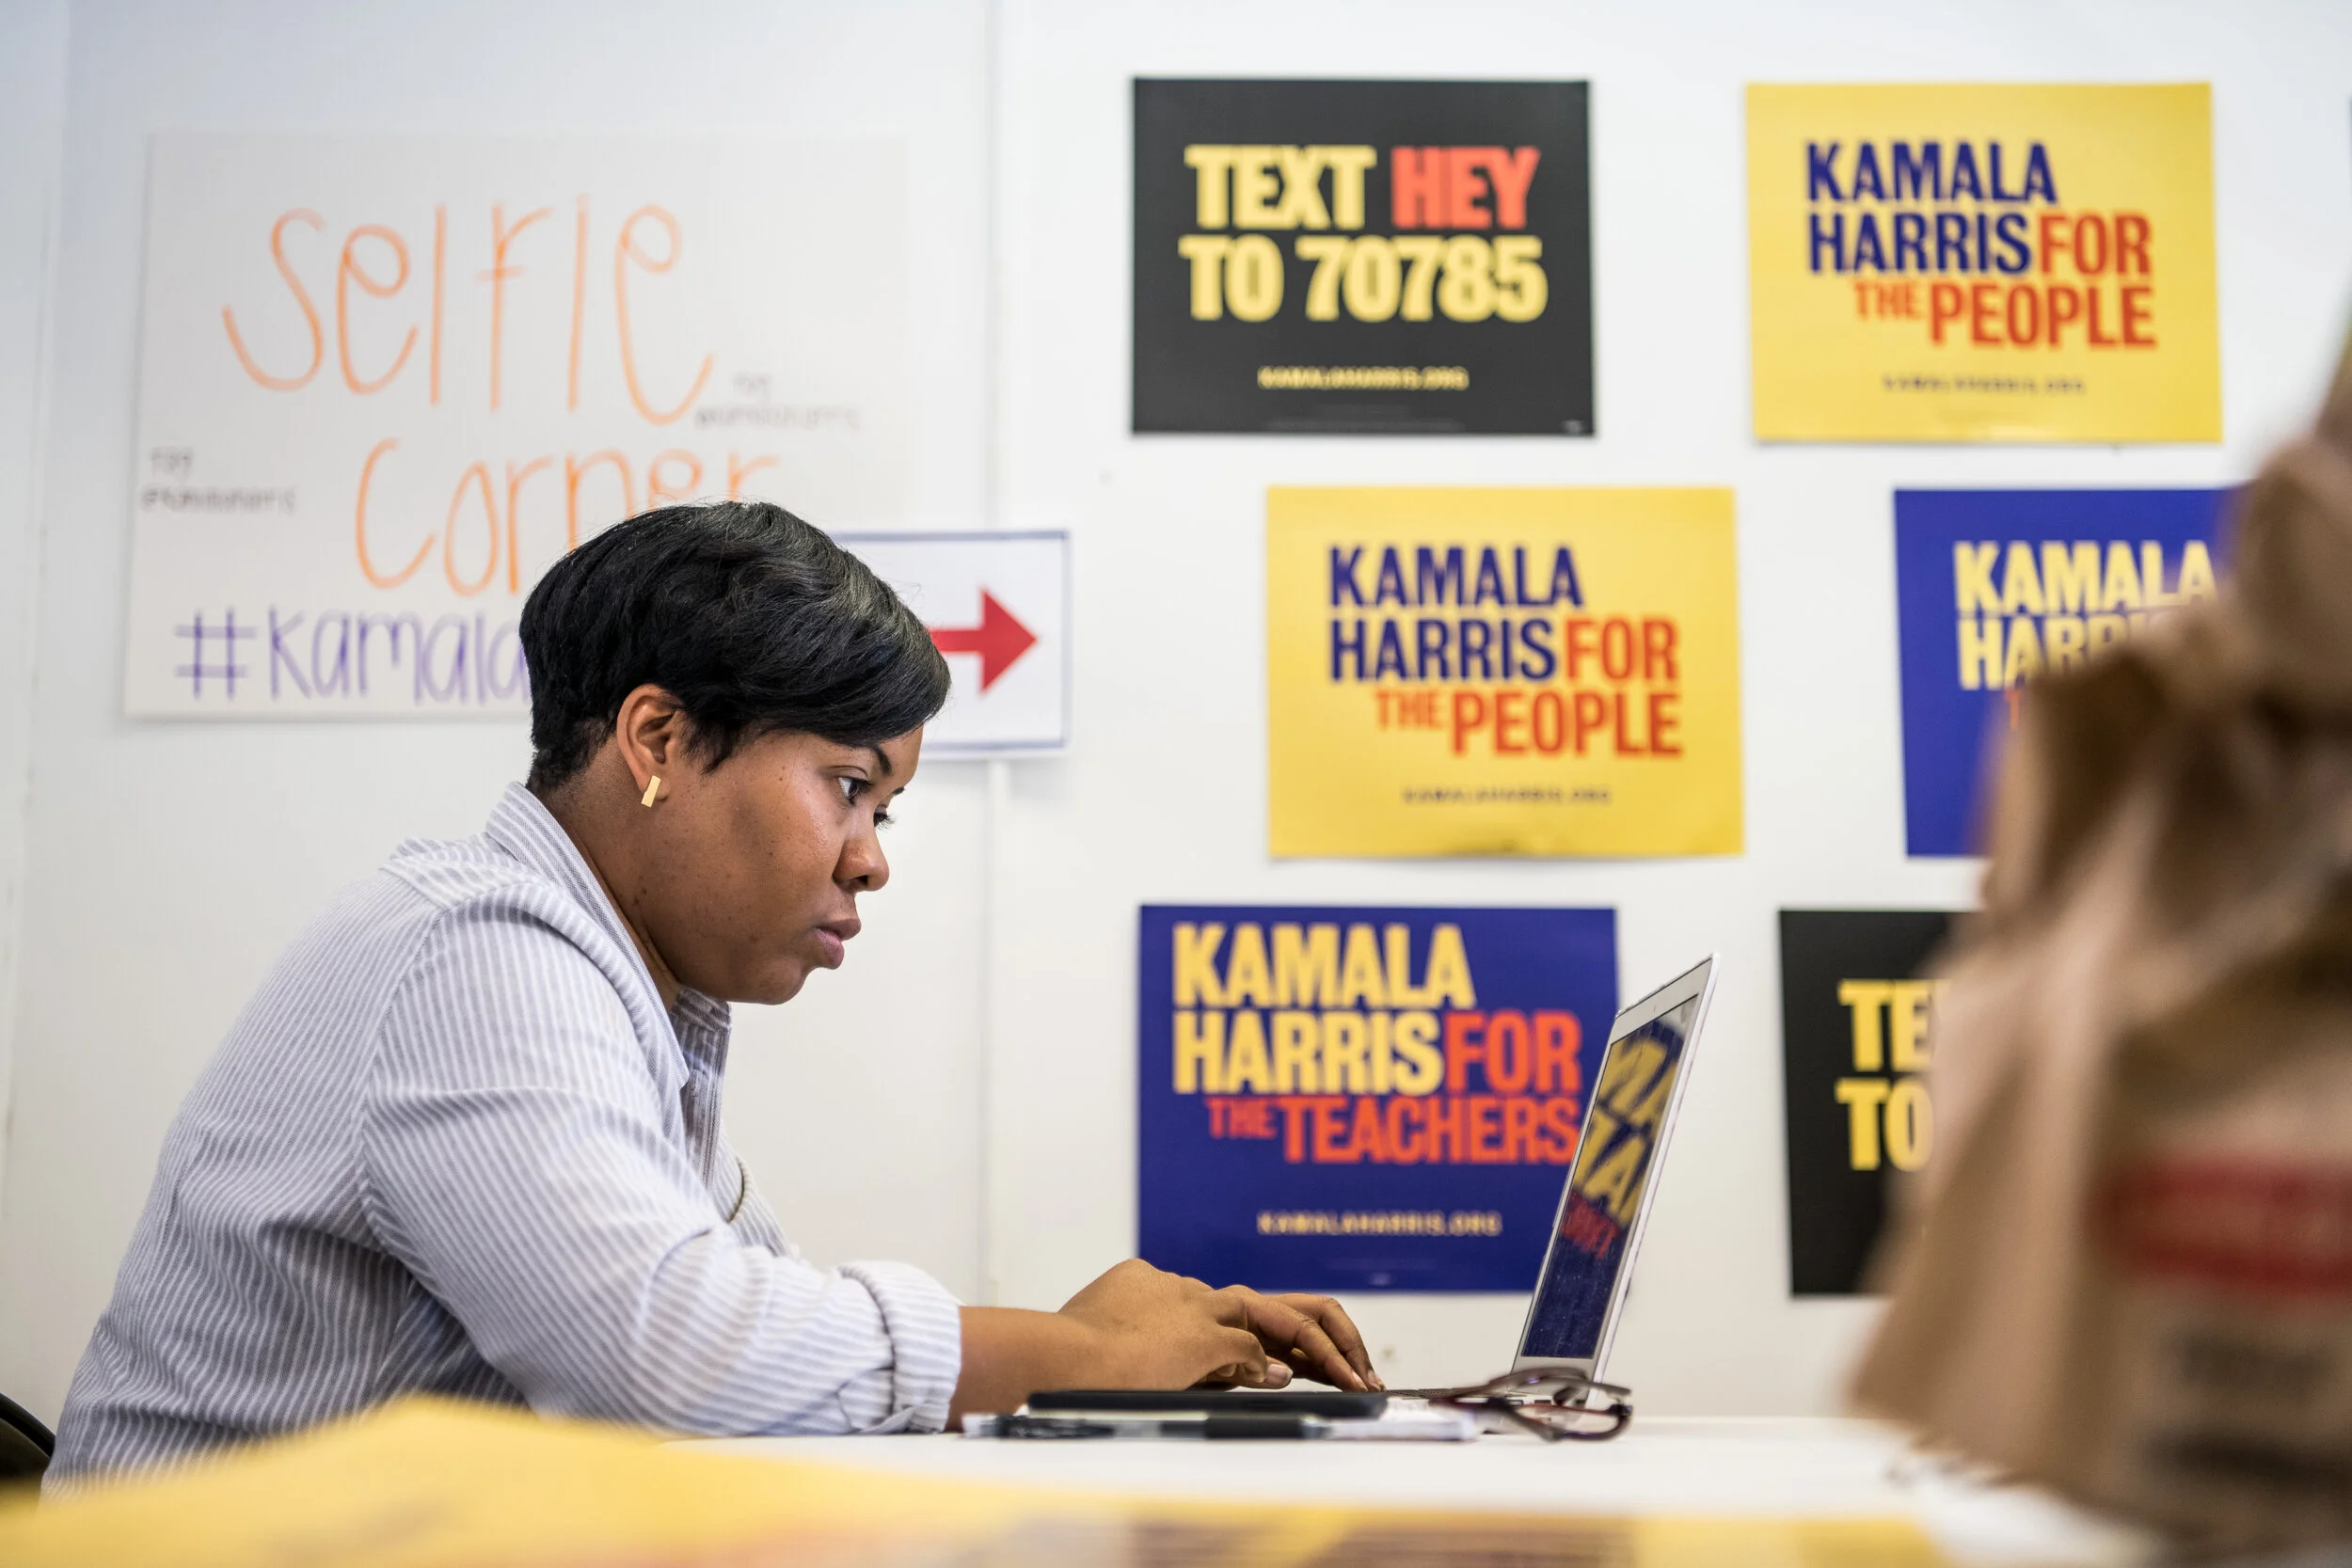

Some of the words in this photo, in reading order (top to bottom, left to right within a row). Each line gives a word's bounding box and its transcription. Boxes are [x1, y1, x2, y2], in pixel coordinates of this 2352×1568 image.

[1184, 144, 1377, 230] TEXT
[1391, 146, 1541, 230] HEY
[1806, 140, 2058, 205] KAMALA
[1178, 234, 1285, 322] TO
[1295, 235, 1549, 323] 70785
[1807, 209, 2033, 277] HARRIS
[2038, 212, 2153, 278] FOR
[1852, 280, 1922, 321] THE
[1928, 281, 2158, 350] PEOPLE
[1328, 545, 1584, 610] KAMALA
[1953, 539, 2219, 612] KAMALA
[1328, 616, 1559, 683] HARRIS
[1563, 615, 1680, 685] FOR
[1375, 689, 1443, 730] THE
[1451, 689, 1684, 759] PEOPLE
[1172, 922, 1477, 1008] KAMALA
[1173, 1009, 1444, 1096] HARRIS
[1445, 1009, 1582, 1095] FOR
[1206, 1096, 1277, 1138] THE
[1278, 1095, 1582, 1165] TEACHERS
[1835, 1077, 1934, 1171] TO
